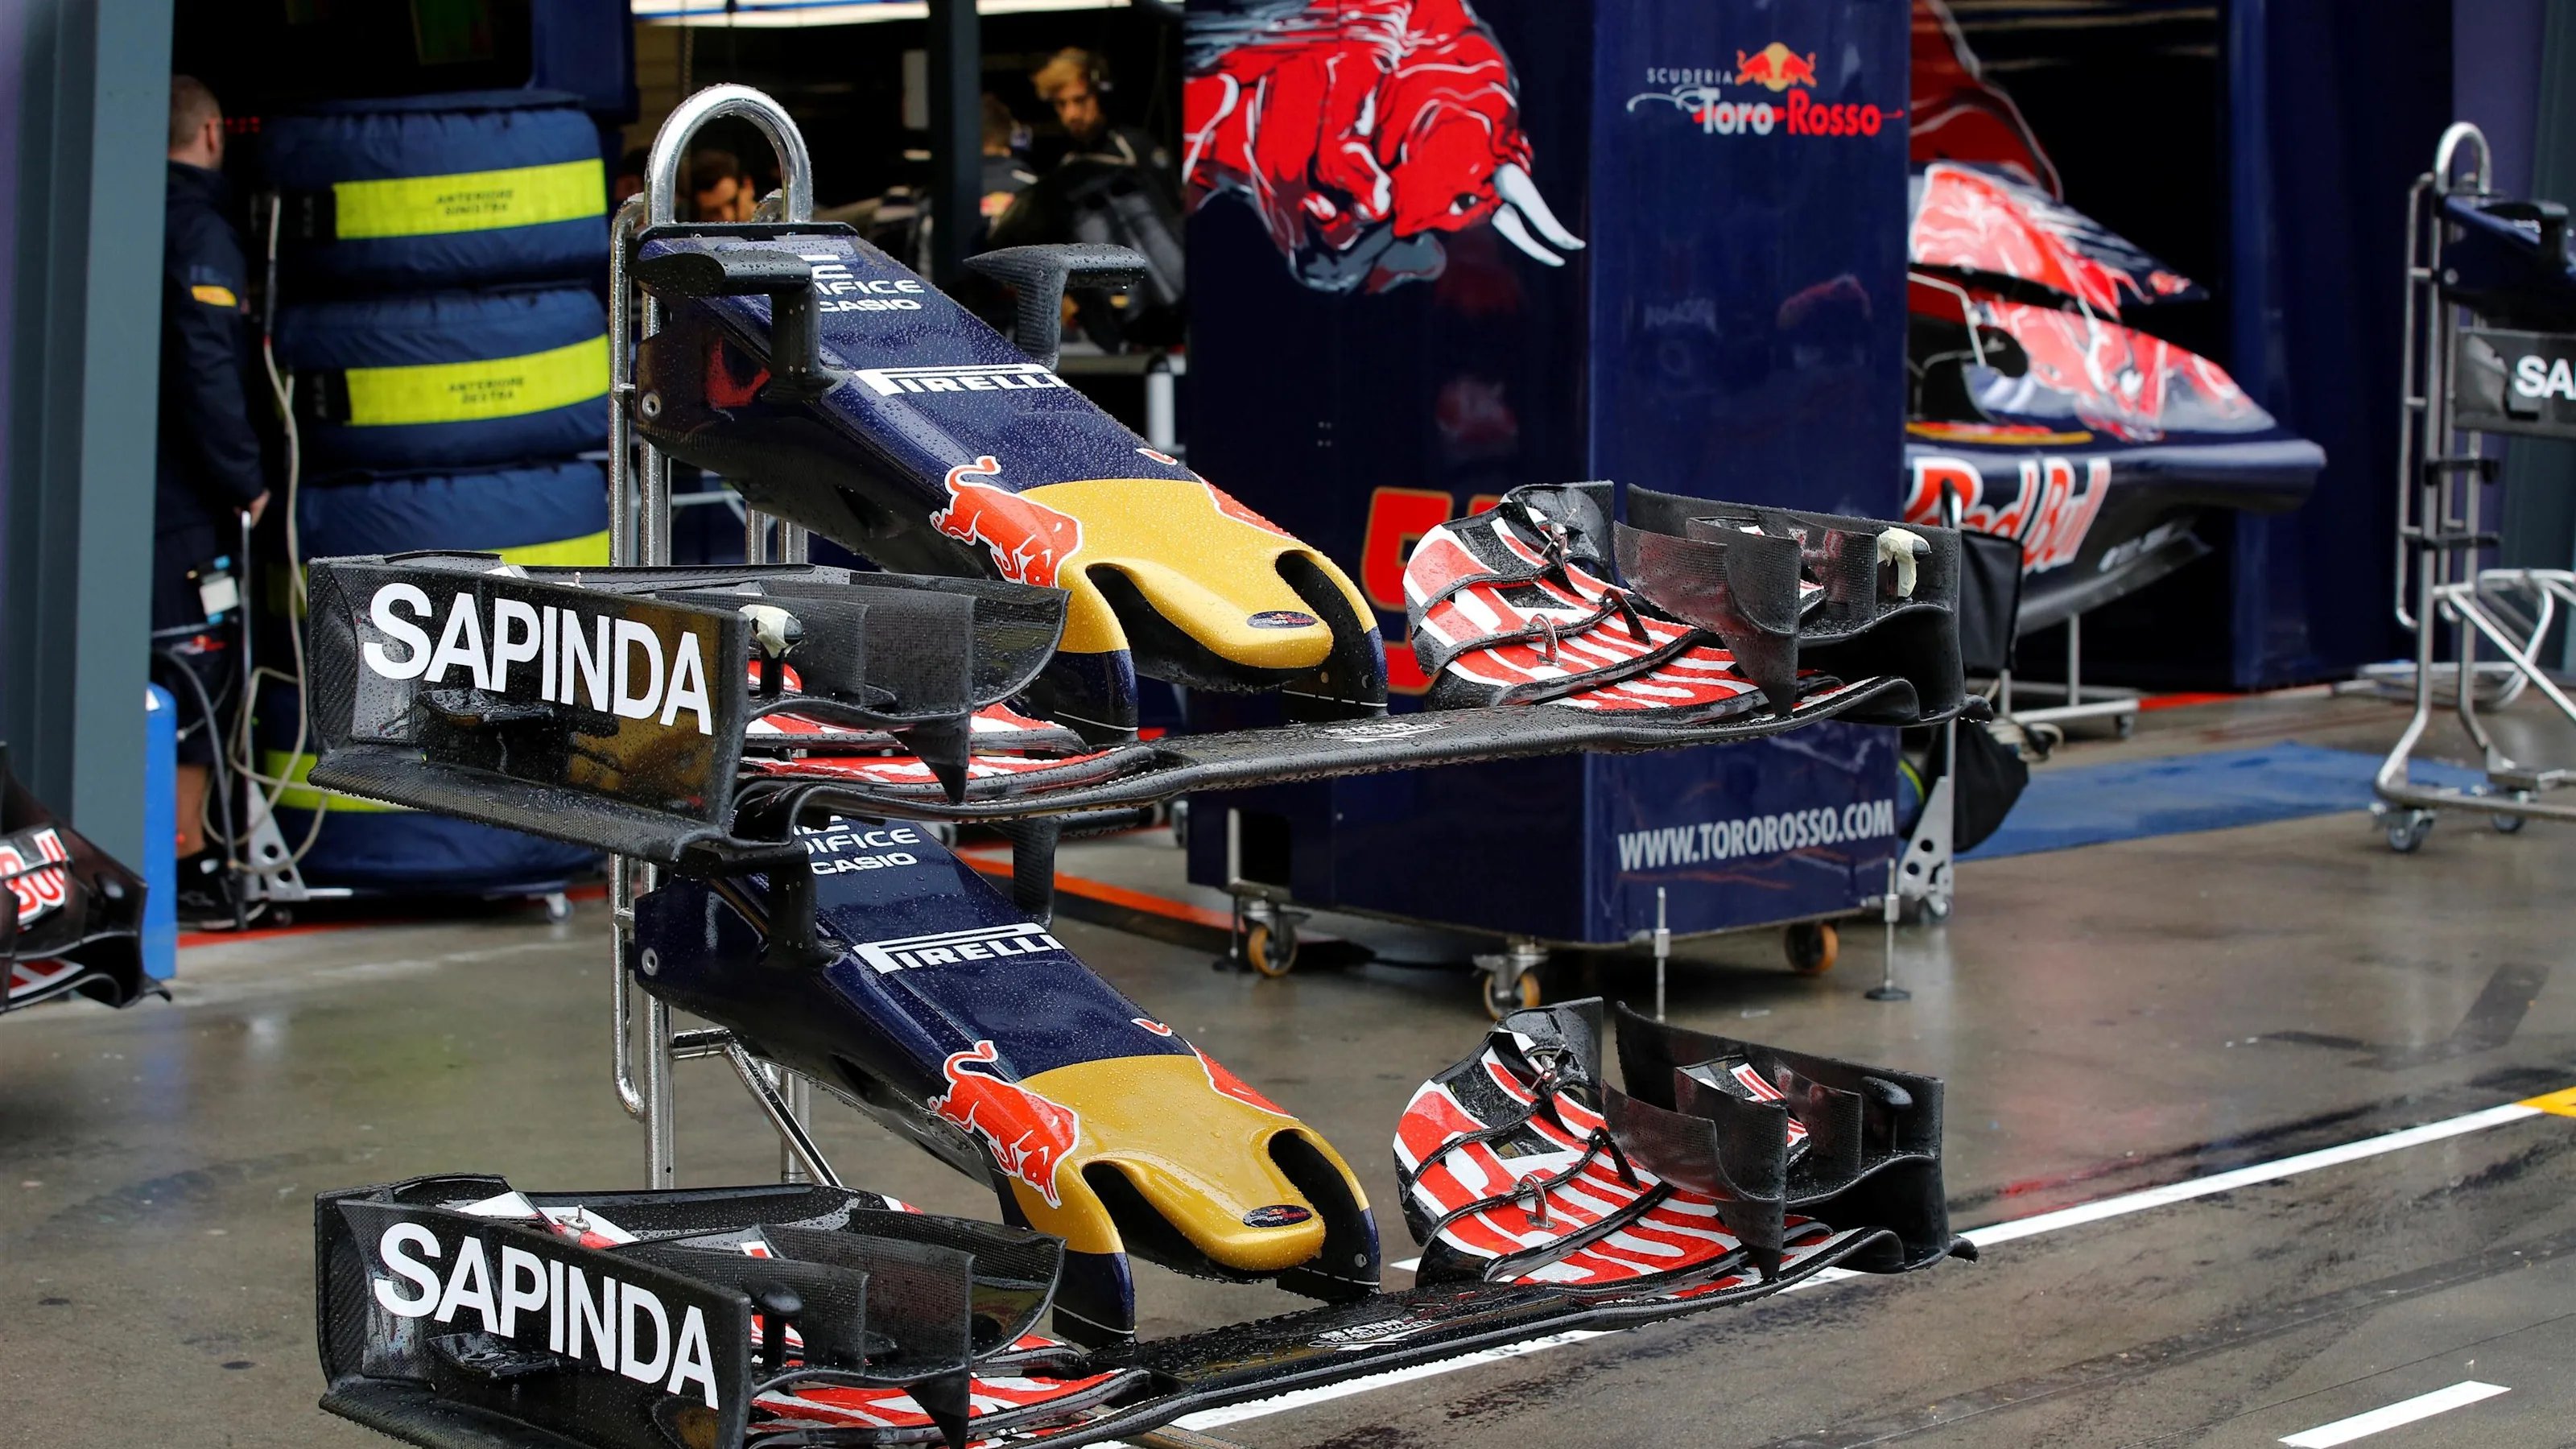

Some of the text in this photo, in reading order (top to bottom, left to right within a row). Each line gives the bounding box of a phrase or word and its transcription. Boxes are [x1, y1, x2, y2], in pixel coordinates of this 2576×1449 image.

[1647, 68, 1733, 85] SCUDERIA
[1698, 87, 1882, 136] Toro Rosso
[436, 189, 514, 204] ANTERIORE
[814, 279, 925, 296] IFICE
[819, 298, 922, 312] CASIO
[448, 377, 524, 392] ANTERIORE
[854, 363, 1070, 397] PIRELLI
[363, 582, 713, 736] SAPINDA
[806, 828, 920, 855] IFICE
[1618, 799, 1894, 872] WWW.TOROROSSO.COM
[810, 852, 919, 875] CASIO
[852, 923, 1066, 974] PIRELLI
[374, 1222, 720, 1410] SAPINDA
